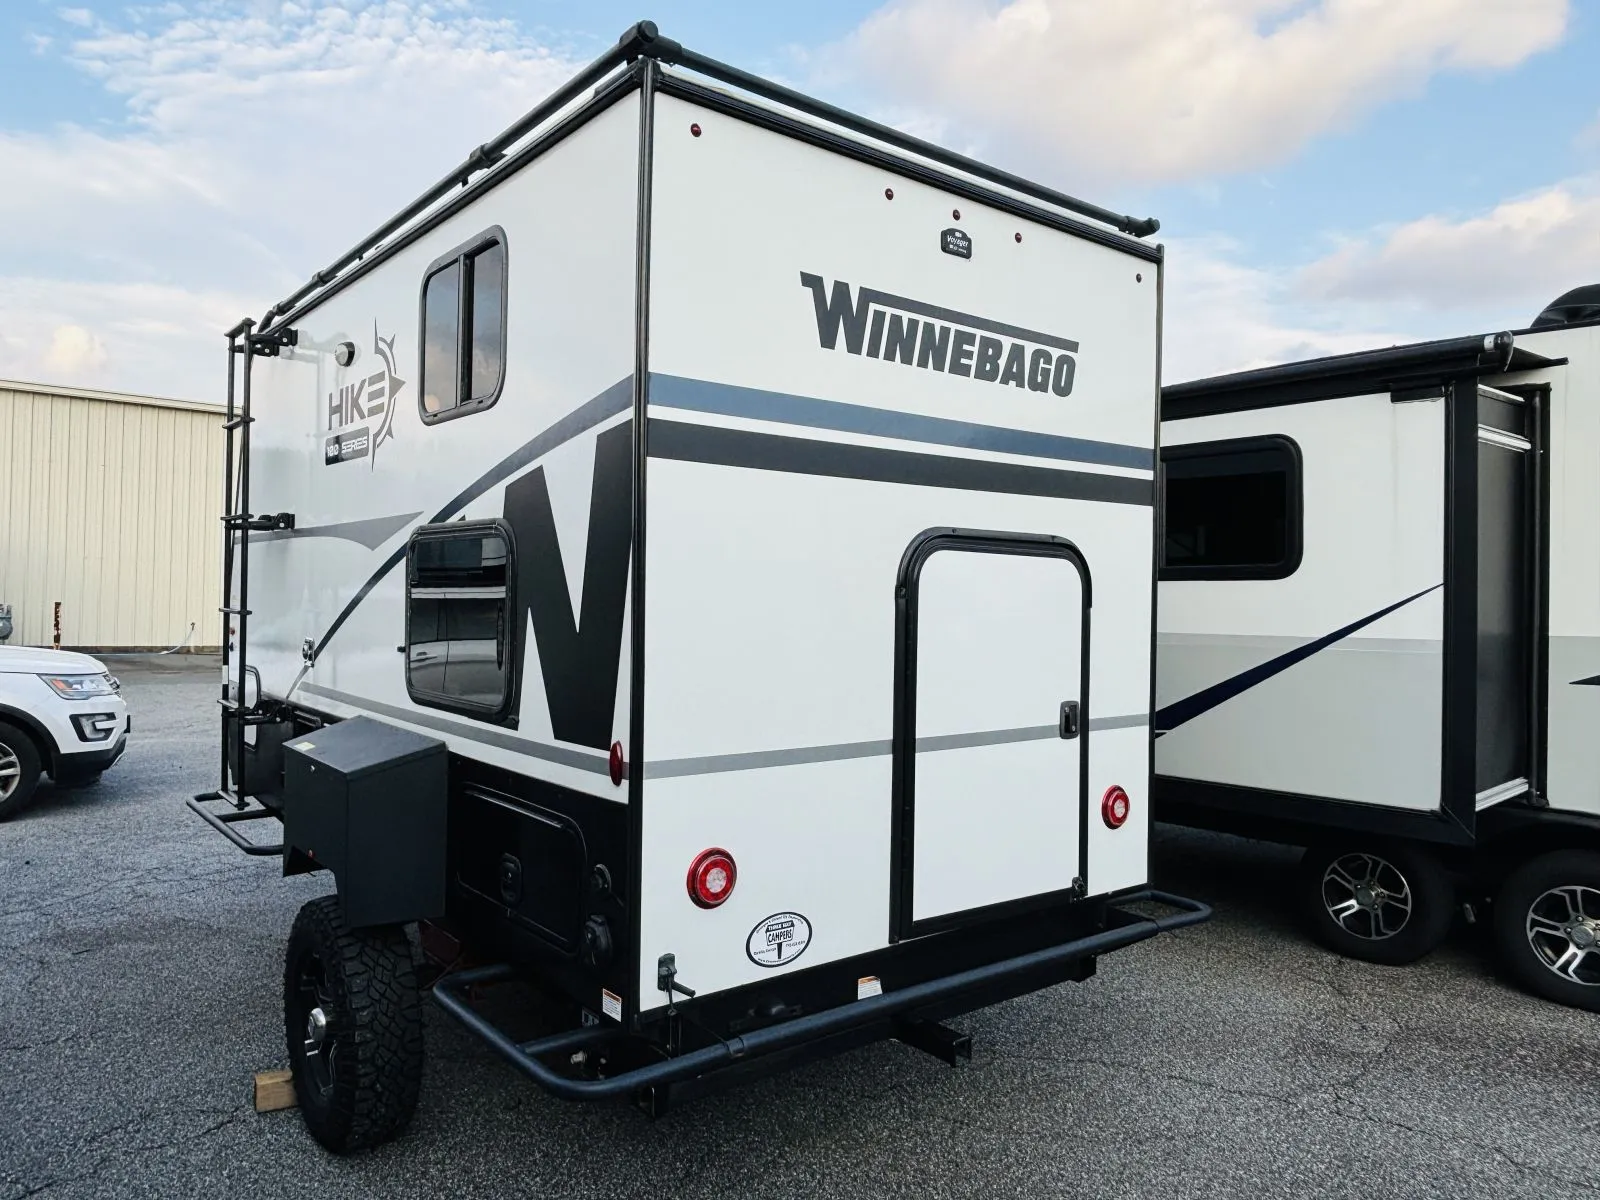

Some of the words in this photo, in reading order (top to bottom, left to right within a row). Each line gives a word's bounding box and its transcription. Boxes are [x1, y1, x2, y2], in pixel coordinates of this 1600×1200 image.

[947, 234, 969, 247] Voyager
[800, 271, 1080, 398] WINNEBAGO
[328, 371, 386, 431] HIKE
[341, 436, 368, 454] SERIES
[768, 929, 792, 943] CAMPERS
